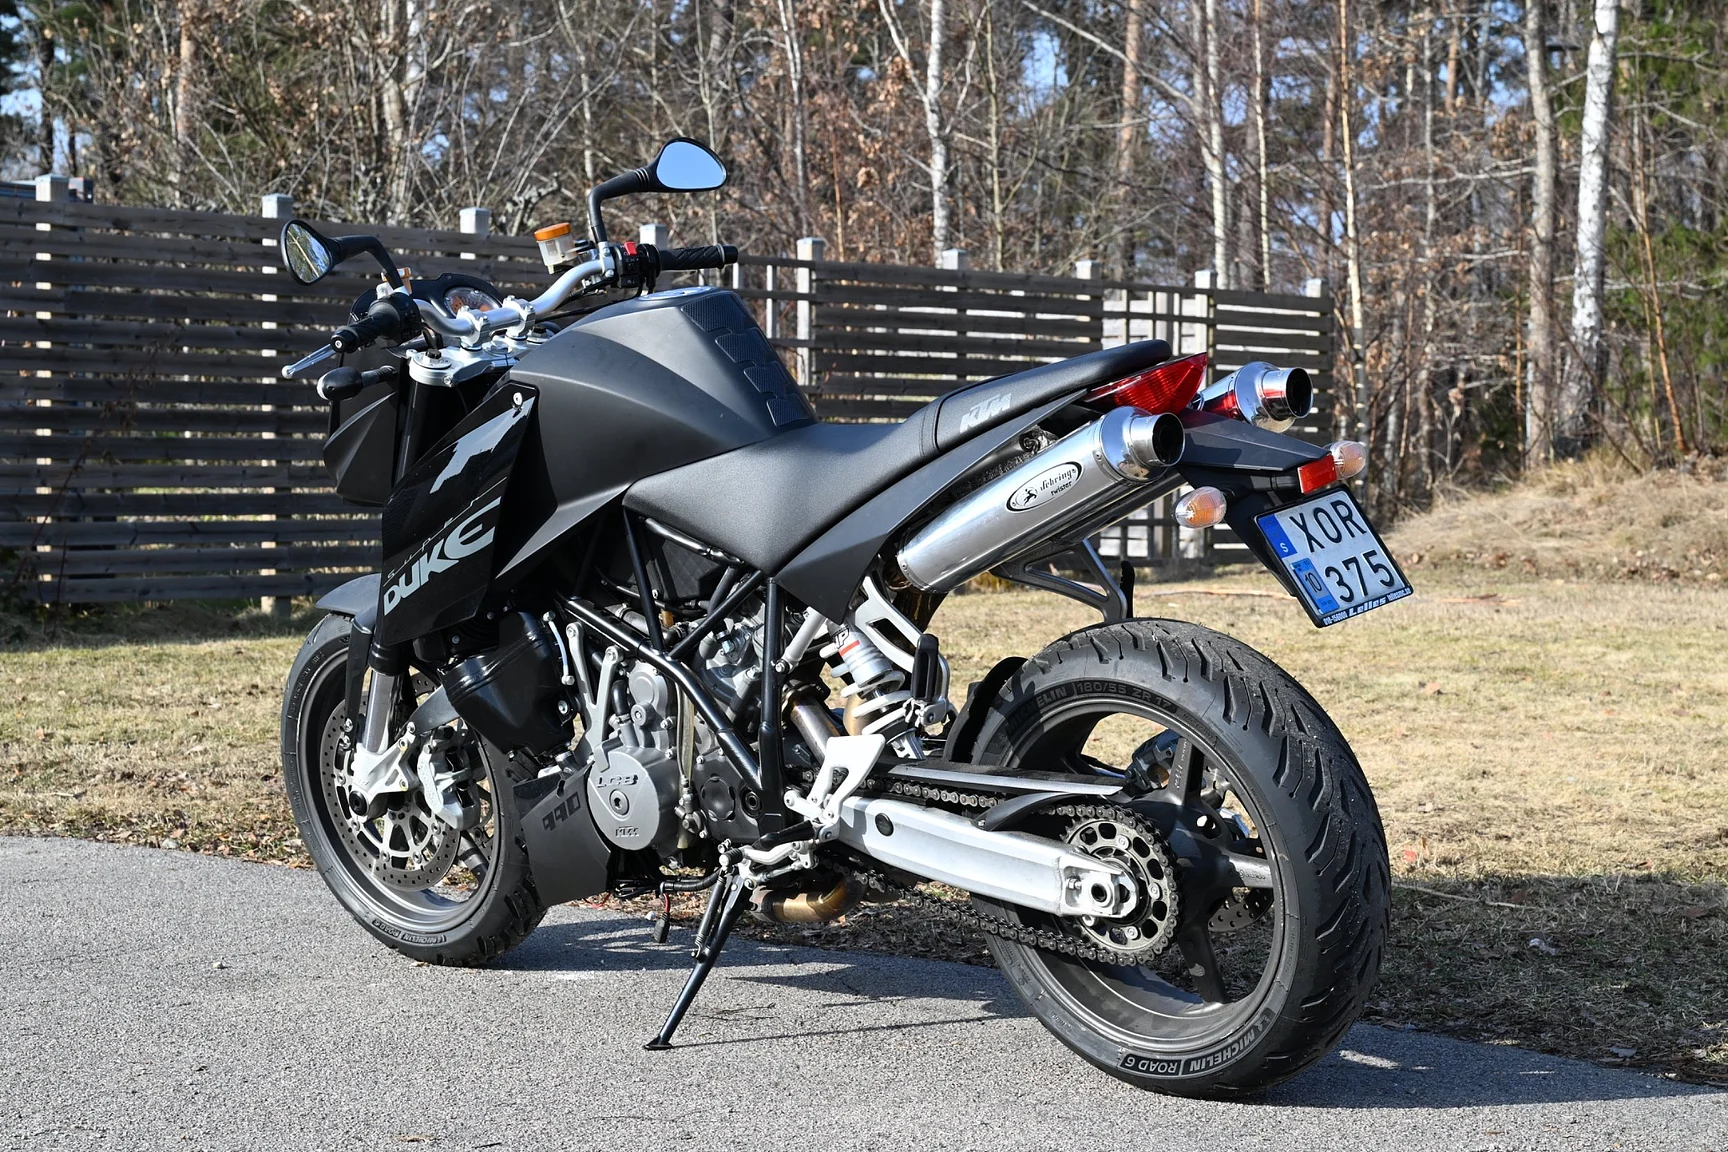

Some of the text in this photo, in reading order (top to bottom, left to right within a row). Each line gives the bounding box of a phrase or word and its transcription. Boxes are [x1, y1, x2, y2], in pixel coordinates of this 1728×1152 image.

[959, 393, 1012, 434] KTM
[1289, 499, 1367, 553] XOR
[383, 496, 502, 617] DUKE
[1279, 542, 1289, 553] S
[1304, 572, 1323, 593] 10
[1324, 549, 1395, 603] 375
[1348, 597, 1387, 617] Lelles
[1076, 681, 1127, 694] 180/55
[1131, 687, 1152, 702] ZR
[1155, 696, 1172, 708] 17
[541, 791, 581, 831] 990
[1124, 1032, 1255, 1074] MICHELIN ROAD 6
